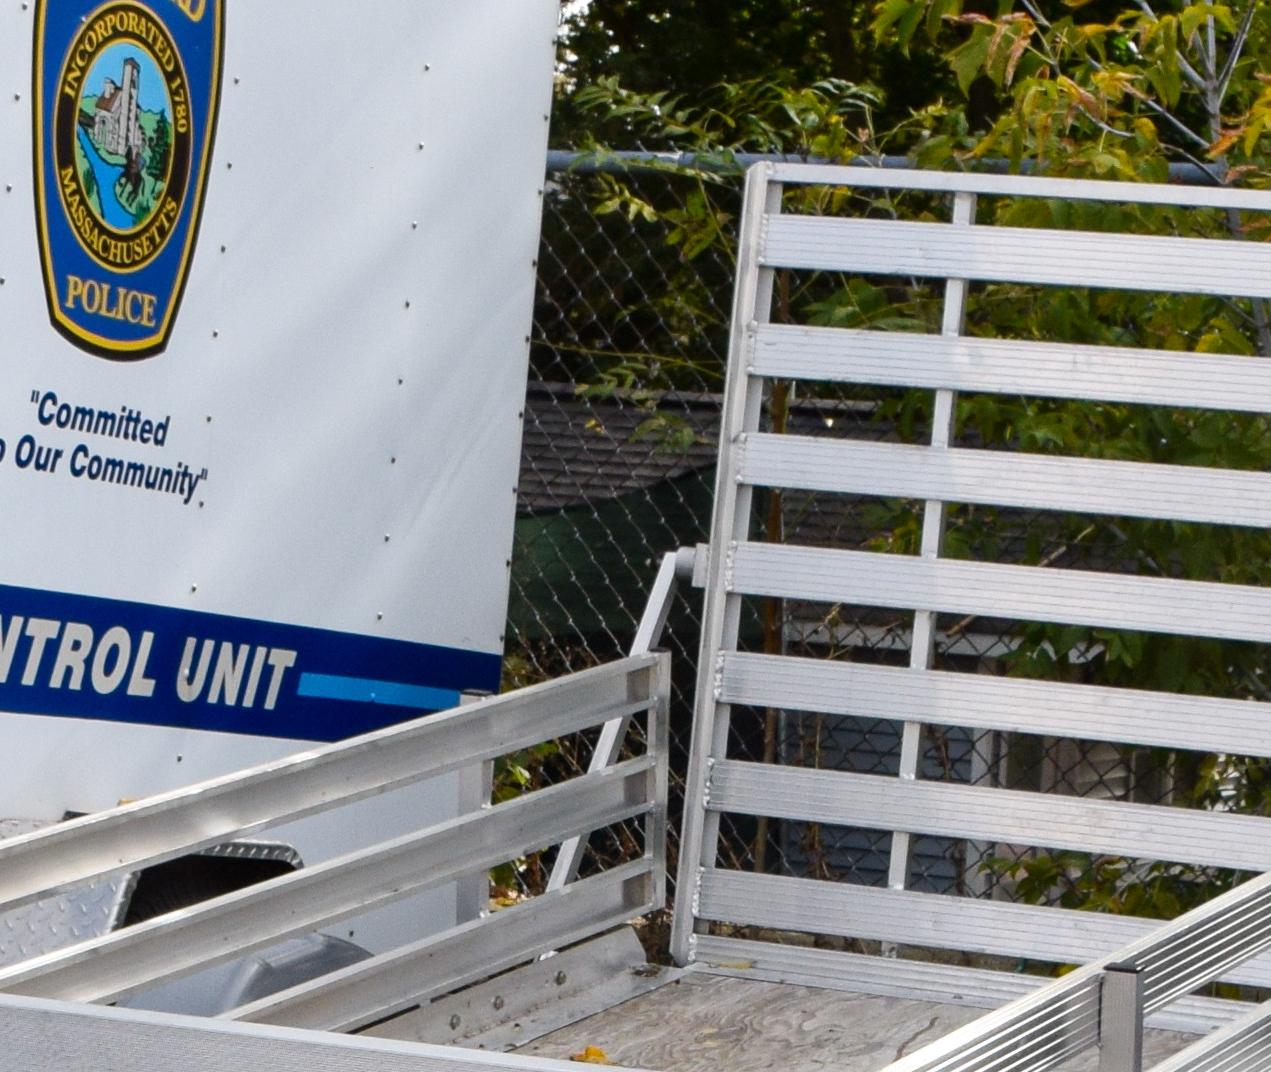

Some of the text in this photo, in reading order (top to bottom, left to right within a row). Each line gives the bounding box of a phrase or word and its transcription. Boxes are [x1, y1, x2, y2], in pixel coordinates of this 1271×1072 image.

[65, 11, 188, 133] INCORPORATED 1780
[60, 168, 178, 264] MASSACHUSETTS
[65, 275, 158, 327] POLICE
[30, 391, 171, 447] "Committed
[15, 435, 63, 476] Our
[70, 447, 209, 506] Community"
[176, 637, 298, 711] UNIT
